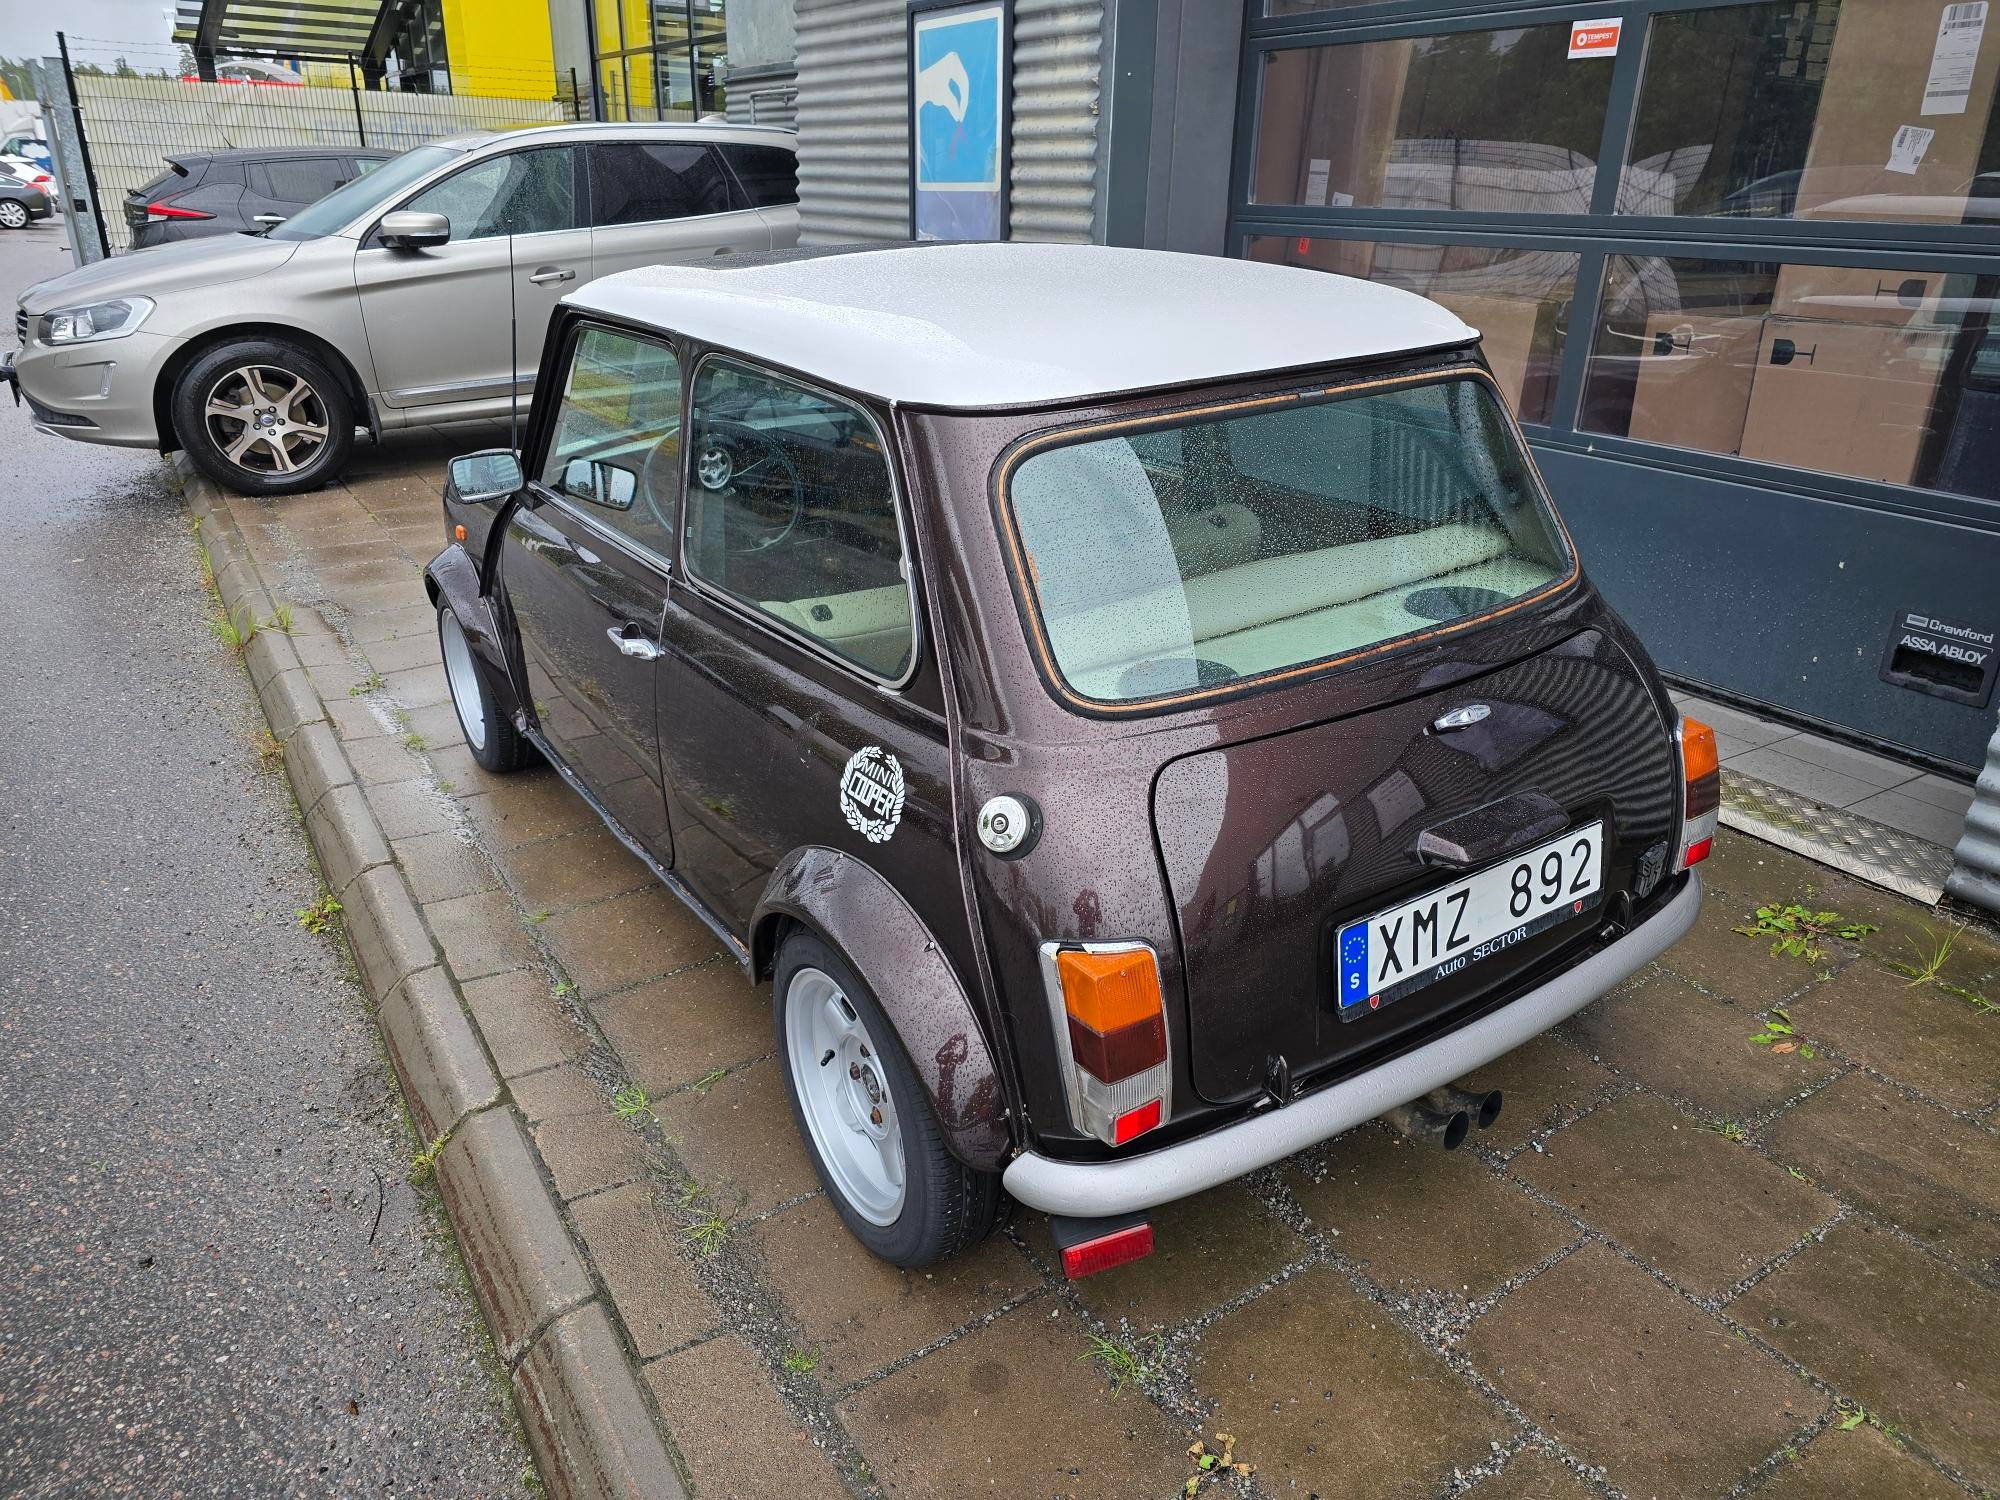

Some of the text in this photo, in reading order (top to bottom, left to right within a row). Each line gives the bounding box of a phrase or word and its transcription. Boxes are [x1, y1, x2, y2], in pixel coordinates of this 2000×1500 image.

[1588, 32, 1613, 40] TEMPEST
[1929, 619, 1994, 644] Crawford
[1900, 634, 1987, 665] ASSA ABLOY
[861, 757, 895, 788] MINI
[847, 770, 897, 820] COOPER
[1378, 838, 1592, 982] XMZ 892
[1435, 926, 1527, 980] Auto SECTOR
[1350, 973, 1360, 989] S
